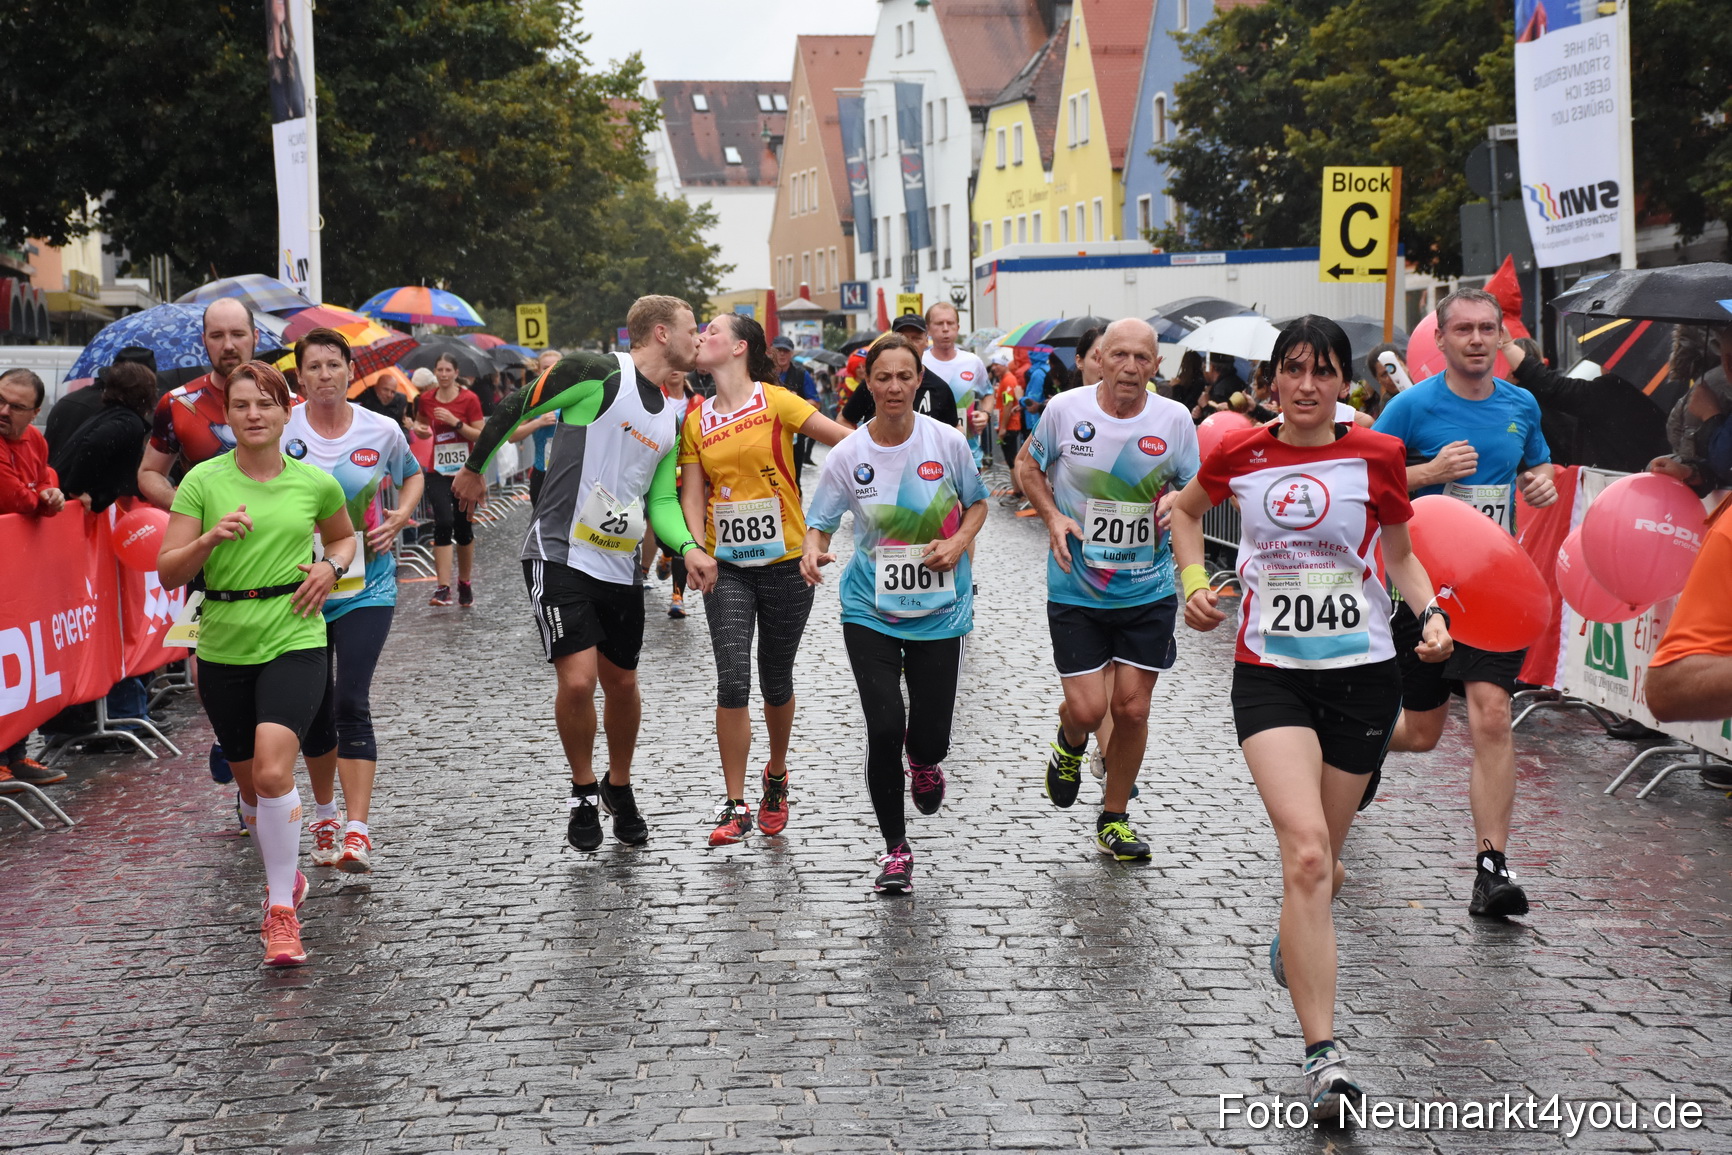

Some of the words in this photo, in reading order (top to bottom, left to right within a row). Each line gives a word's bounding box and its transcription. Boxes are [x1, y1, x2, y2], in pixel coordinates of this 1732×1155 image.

[1332, 172, 1391, 192] Block
[1340, 202, 1379, 258] C
[900, 295, 920, 304] Block
[520, 306, 542, 315] Block
[525, 318, 540, 339] D
[702, 428, 731, 450] MAX
[734, 414, 772, 434] BÖGL
[1070, 444, 1094, 453] PARTL
[1070, 450, 1094, 458] Neumarkt
[437, 451, 466, 465] 2035
[855, 487, 878, 496] PARTL
[856, 492, 879, 500] Neumarkt
[600, 510, 628, 535] 25
[719, 514, 776, 543] 2683
[1091, 516, 1149, 545] 2016
[588, 532, 620, 549] Markus
[1318, 540, 1349, 554] HERZ
[732, 547, 765, 560] Sandra
[1103, 549, 1136, 562] Ludwig
[1273, 551, 1291, 560] Heck
[1297, 551, 1309, 559] Dr.
[884, 563, 944, 590] 3061
[1307, 571, 1355, 585] BOCK
[1267, 580, 1301, 588] NeuerMarkt
[898, 595, 922, 608] Rita
[1270, 593, 1361, 632] 2048
